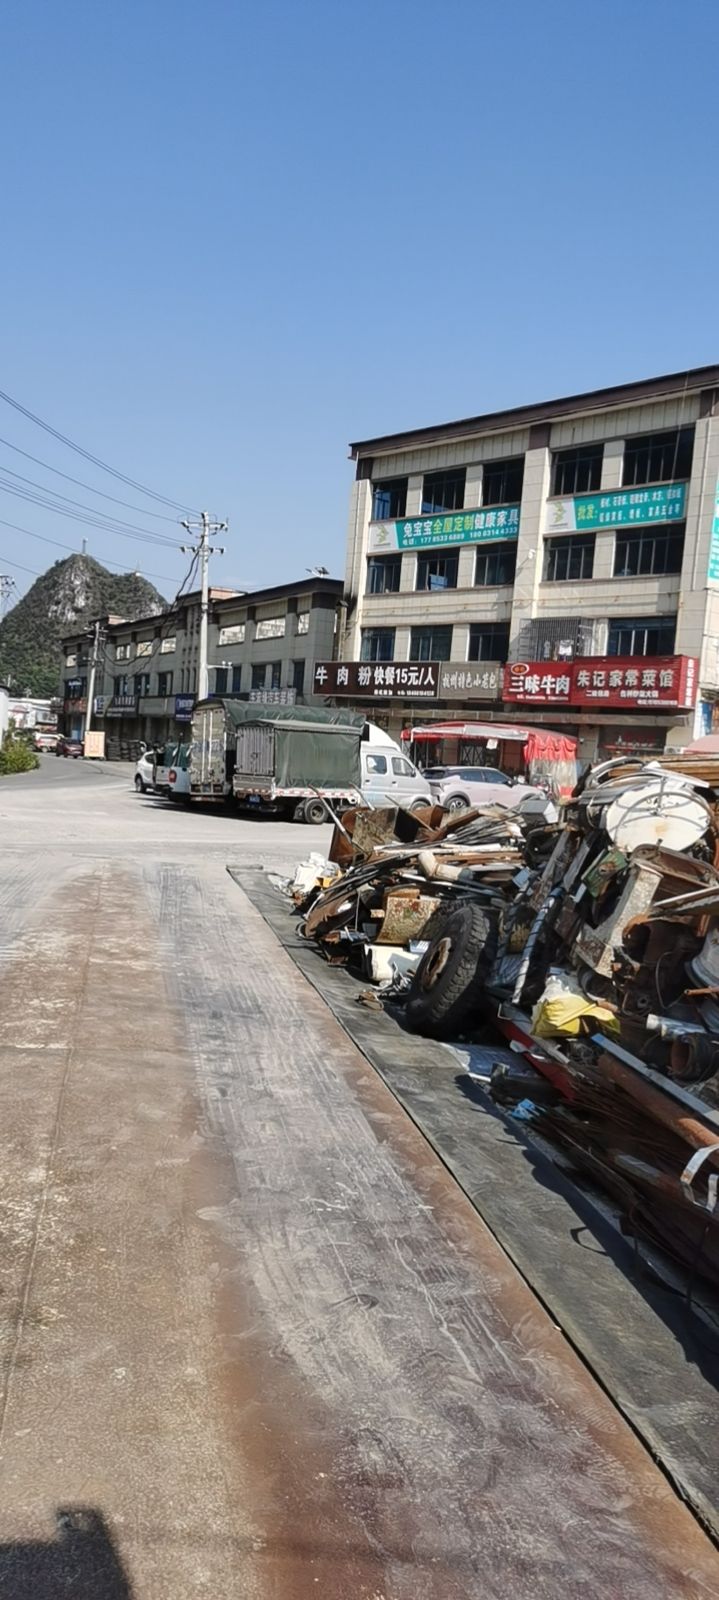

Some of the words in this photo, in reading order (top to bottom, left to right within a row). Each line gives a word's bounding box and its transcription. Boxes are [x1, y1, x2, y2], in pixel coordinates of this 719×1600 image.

[403, 508, 519, 537] 兔宝宝全屋定制健康家具
[373, 665, 435, 686] 快餐15元/人
[509, 675, 571, 694] 三味牛肉
[577, 669, 674, 688] 朱记家常菜馆
